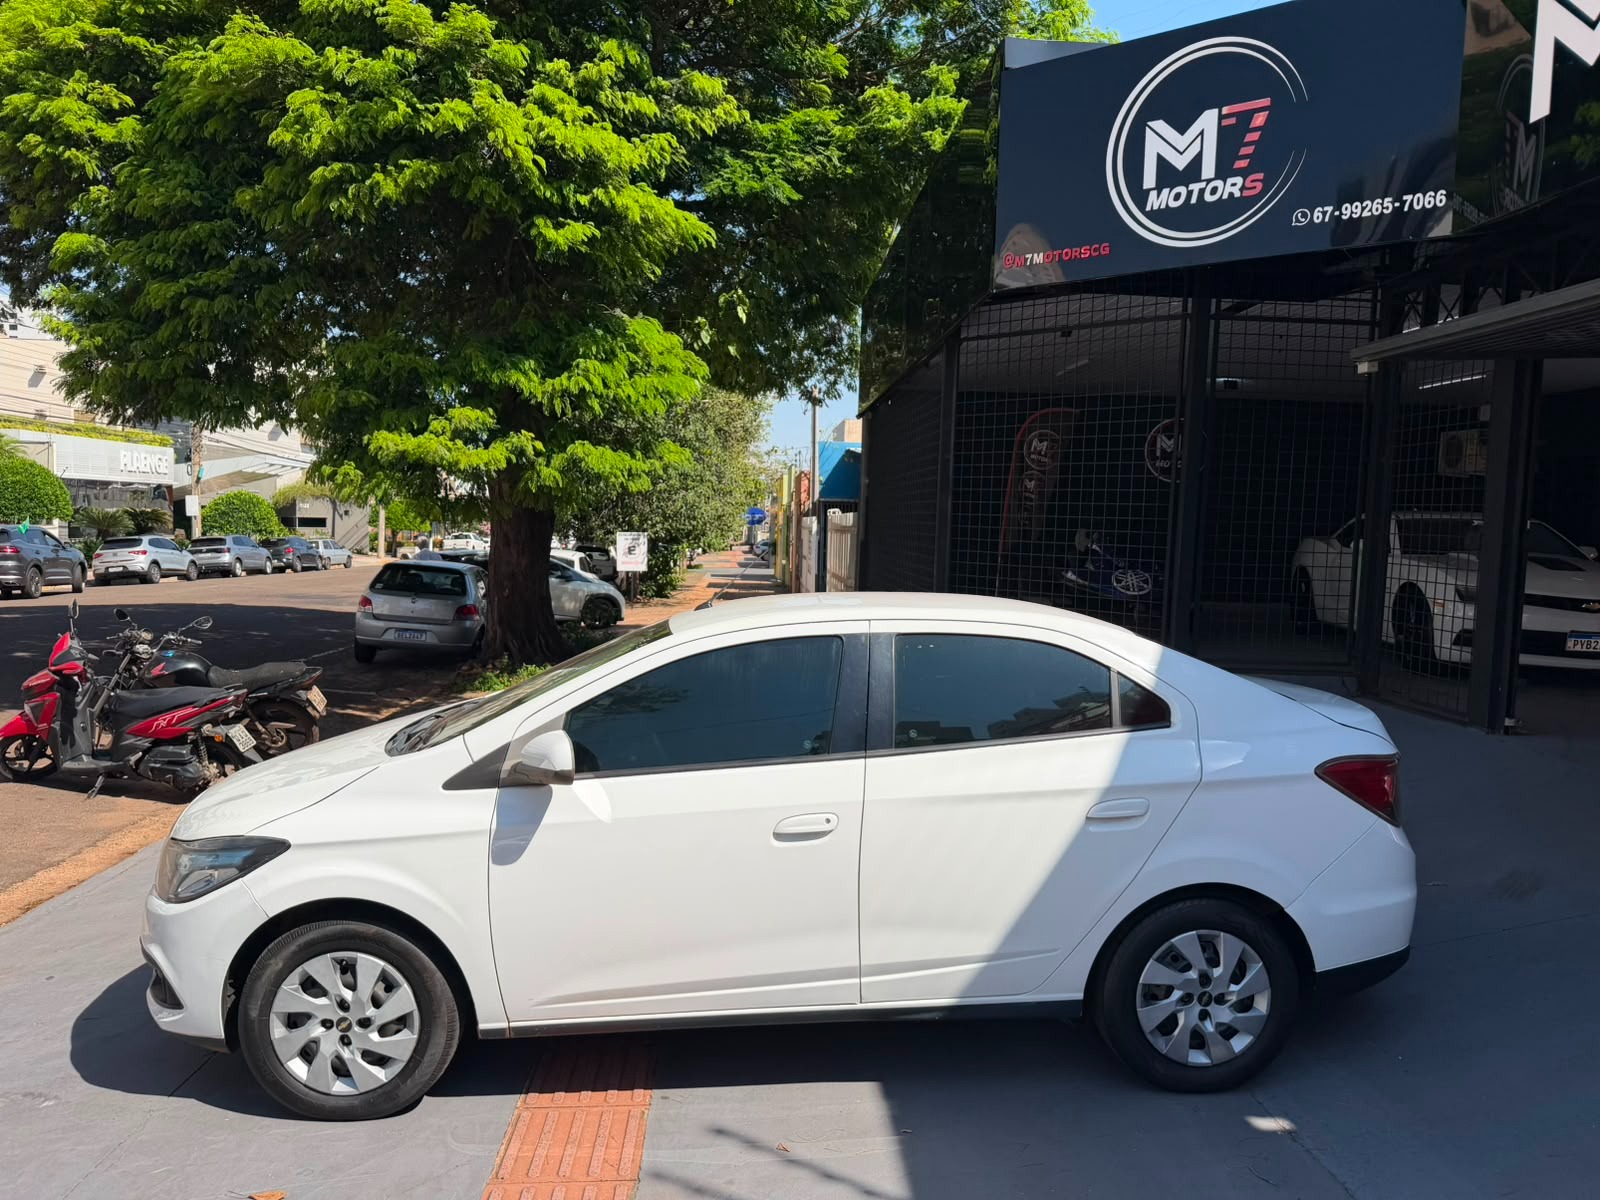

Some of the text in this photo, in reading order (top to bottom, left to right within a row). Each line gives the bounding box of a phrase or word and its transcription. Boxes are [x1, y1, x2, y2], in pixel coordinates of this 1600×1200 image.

[1143, 97, 1271, 190] M7
[1145, 172, 1264, 211] MOTORS
[1313, 189, 1447, 223] 67-99265-7066
[1003, 242, 1110, 269] @M7MOTORSCG
[1572, 639, 1600, 650] PYB2
